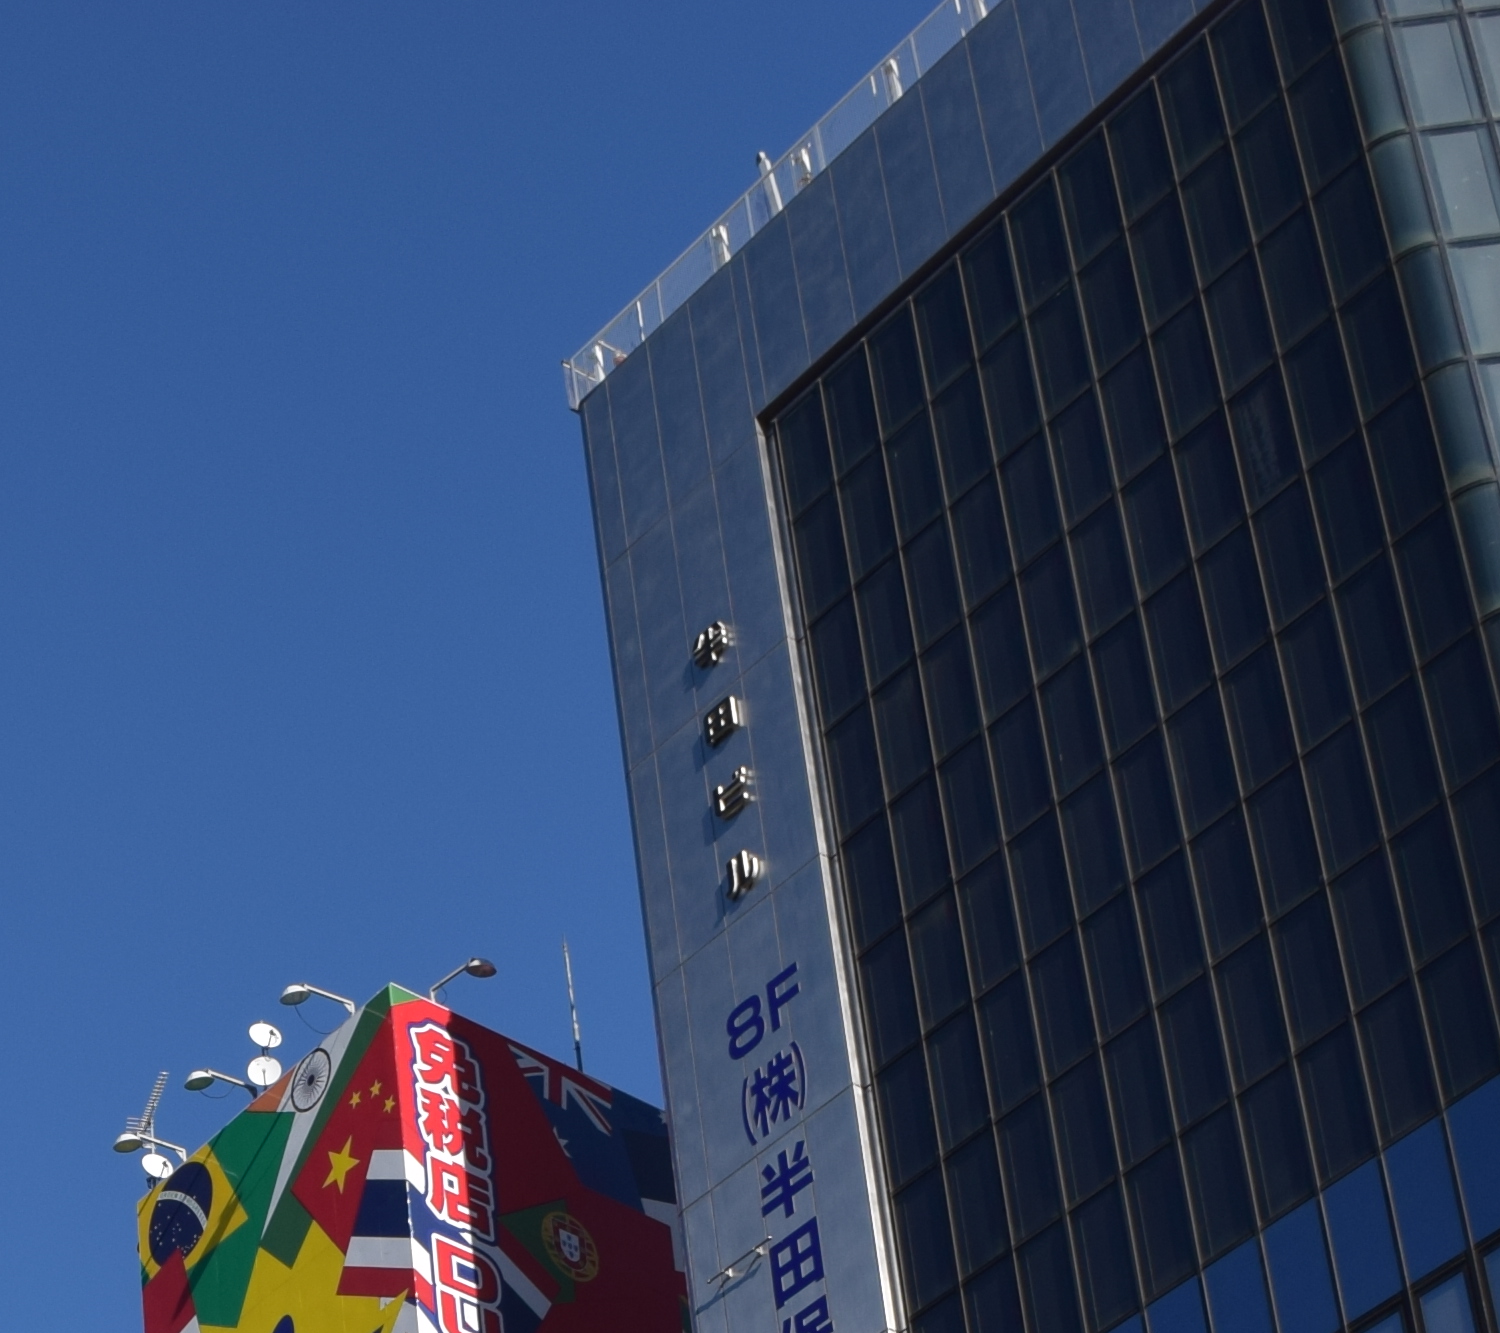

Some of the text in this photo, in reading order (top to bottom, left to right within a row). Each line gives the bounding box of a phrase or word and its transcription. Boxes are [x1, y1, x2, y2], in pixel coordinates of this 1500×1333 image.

[725, 961, 801, 1060] 8F
[410, 1020, 494, 1240] 免税店
